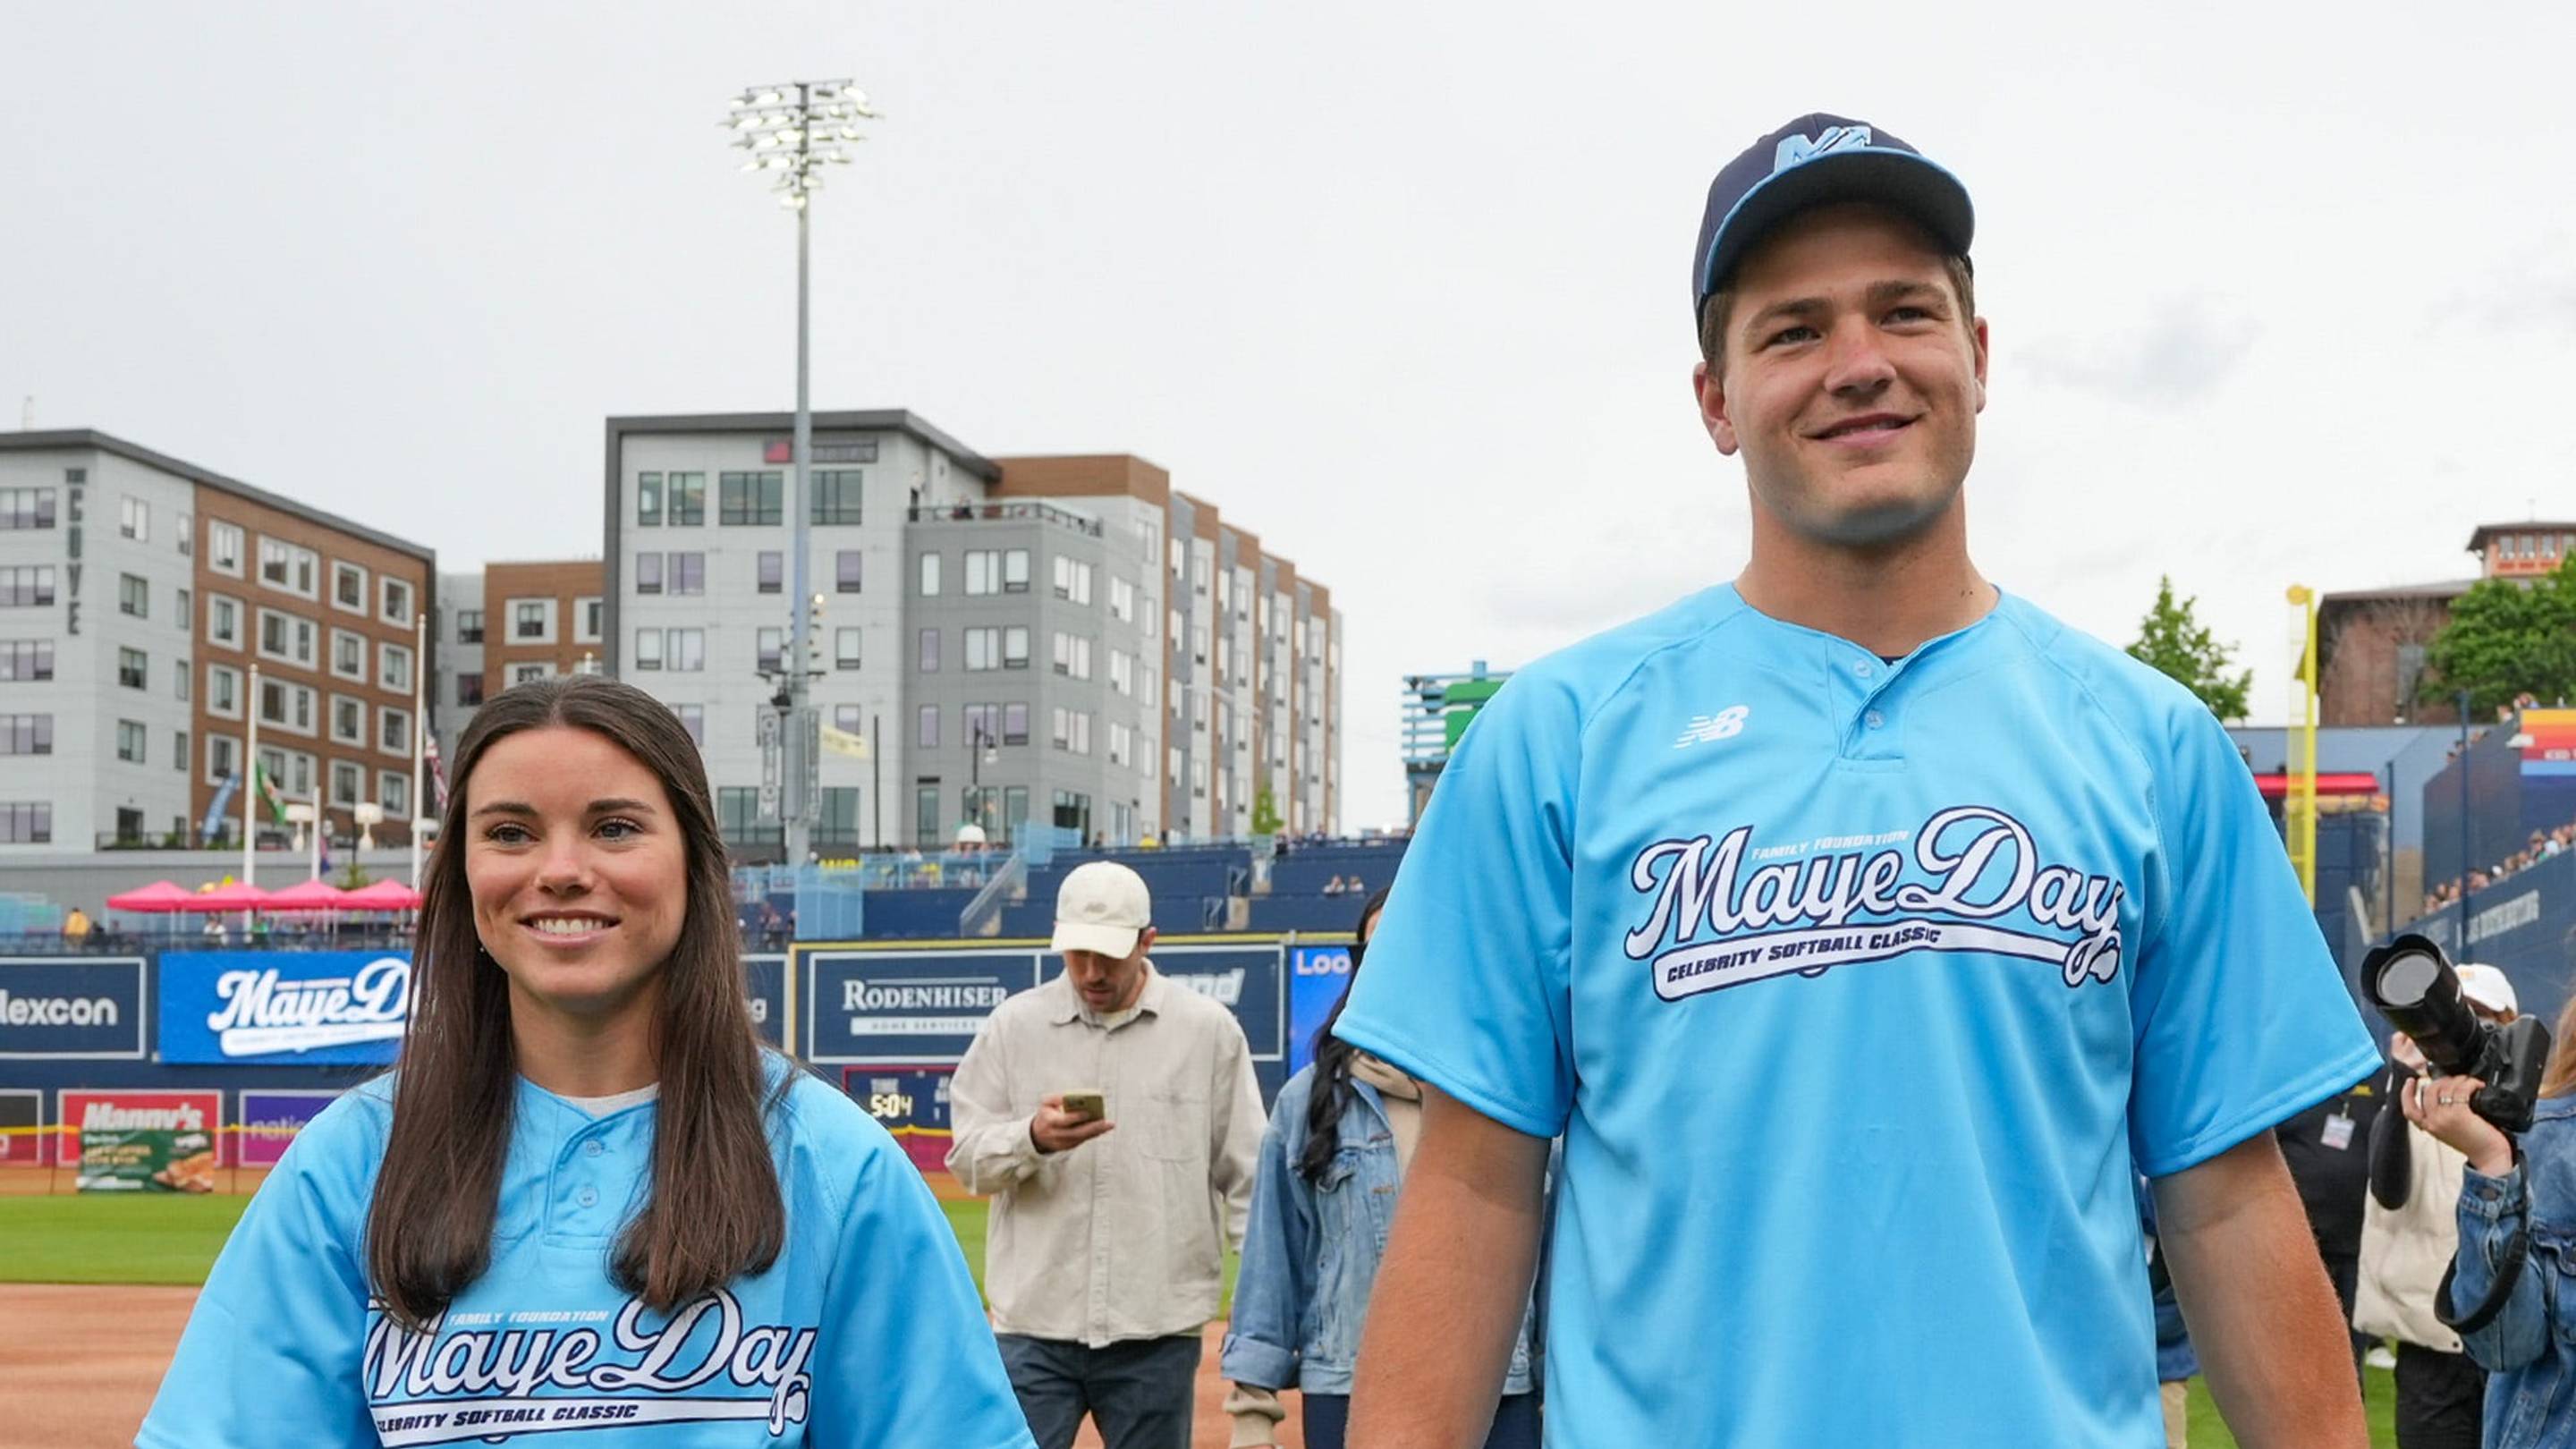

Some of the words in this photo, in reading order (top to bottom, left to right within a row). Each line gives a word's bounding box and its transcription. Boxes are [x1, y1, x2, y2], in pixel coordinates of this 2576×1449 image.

[1751, 841, 1809, 862] FAMILY
[1814, 830, 1911, 853] FOUNDATION
[1623, 825, 1903, 962] Maye
[1894, 804, 2124, 987] Day
[1666, 946, 1764, 985] CELEBRITY
[1768, 934, 1863, 962] SOFTBALL
[1868, 926, 1942, 950] CLASSIC
[208, 969, 350, 1032] Maye
[843, 979, 1008, 1011] RODENHISER
[449, 1312, 503, 1326] FAMILY
[509, 1310, 608, 1325] FOUNDATION
[589, 1286, 818, 1437] Day
[377, 1413, 448, 1433] LEBRITY
[453, 1406, 546, 1427] SOFTBALL
[554, 1403, 640, 1421] CLASSIC
